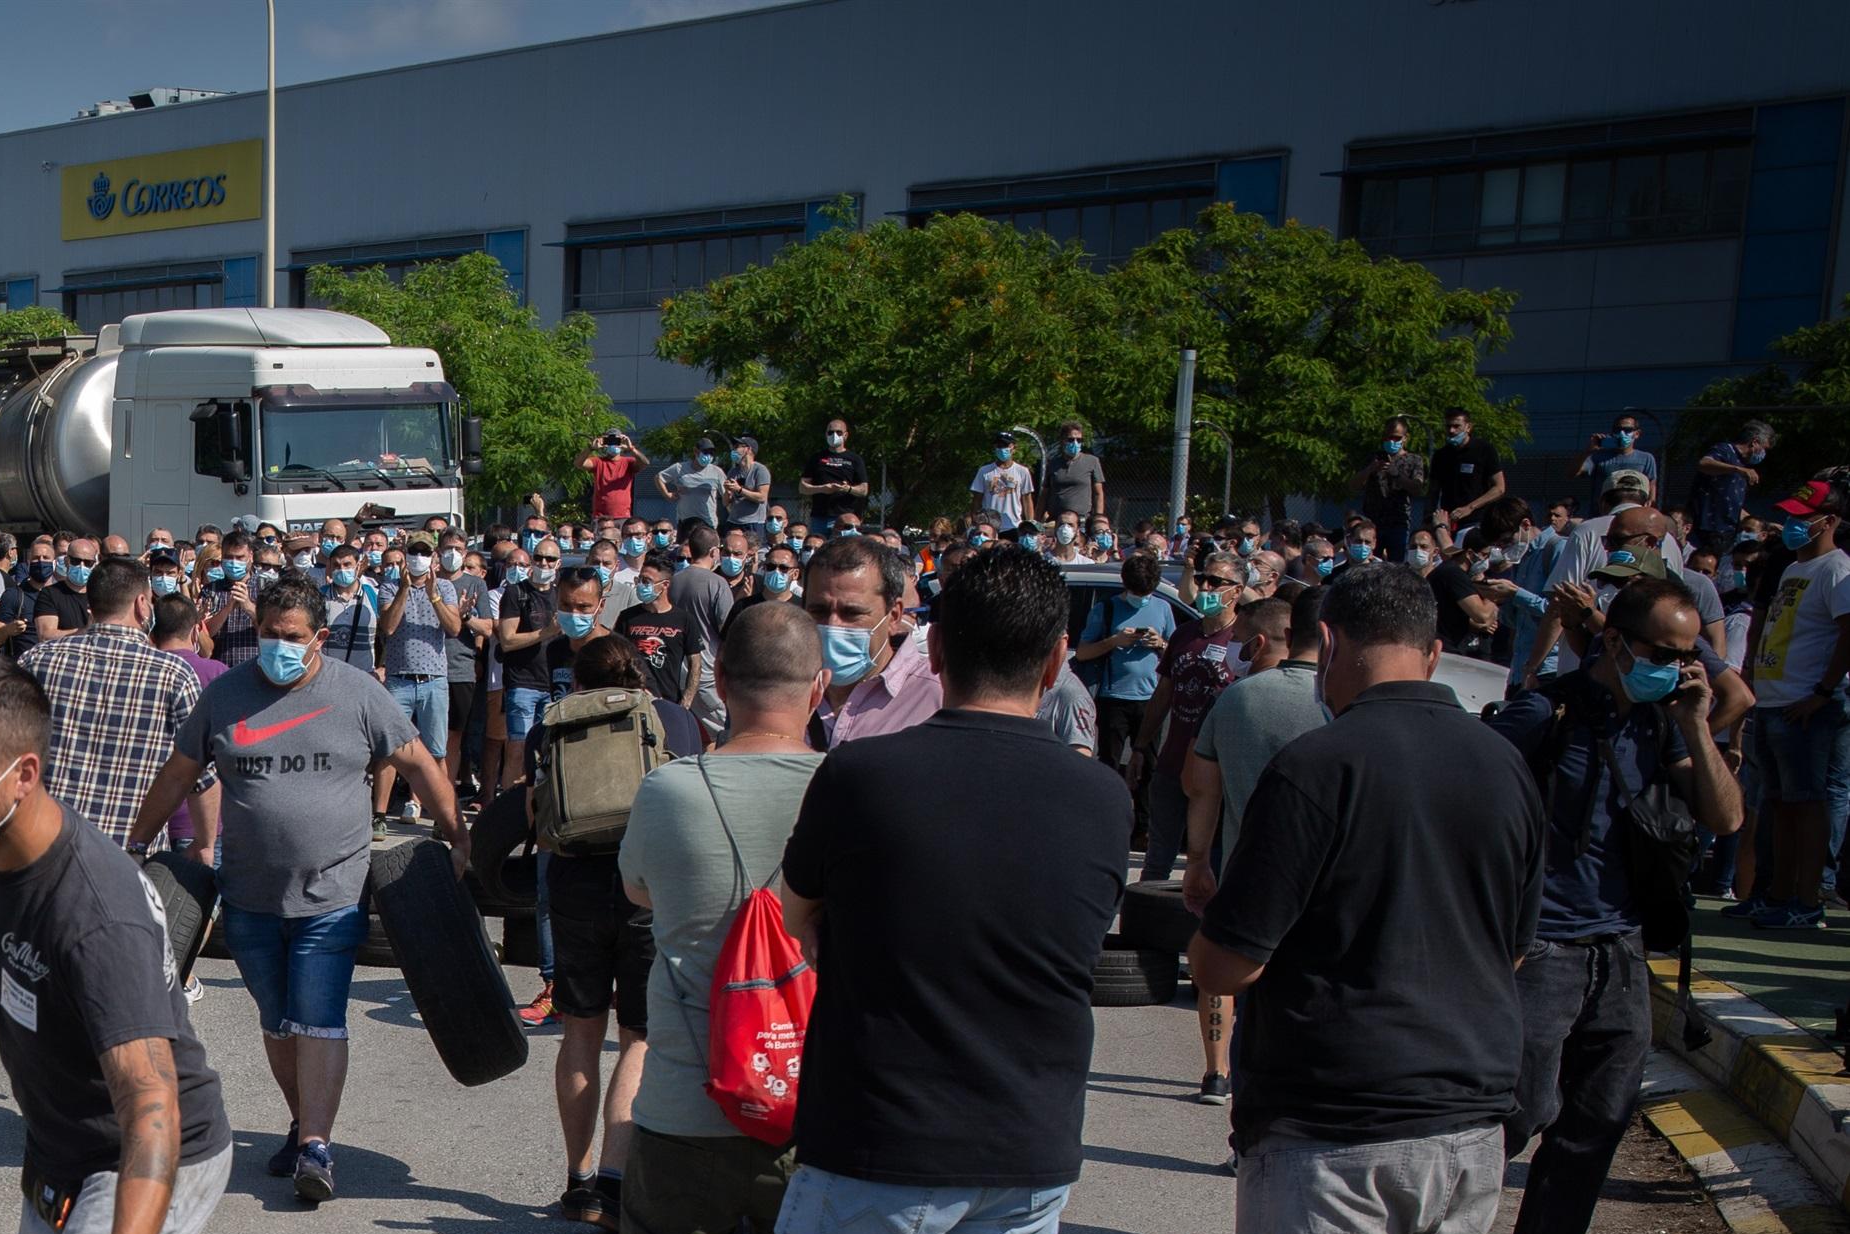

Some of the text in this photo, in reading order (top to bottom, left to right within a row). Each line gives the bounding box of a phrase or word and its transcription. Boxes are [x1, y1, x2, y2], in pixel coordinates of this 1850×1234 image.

[289, 522, 324, 533] DAF
[237, 752, 332, 774] JUST DO IT.
